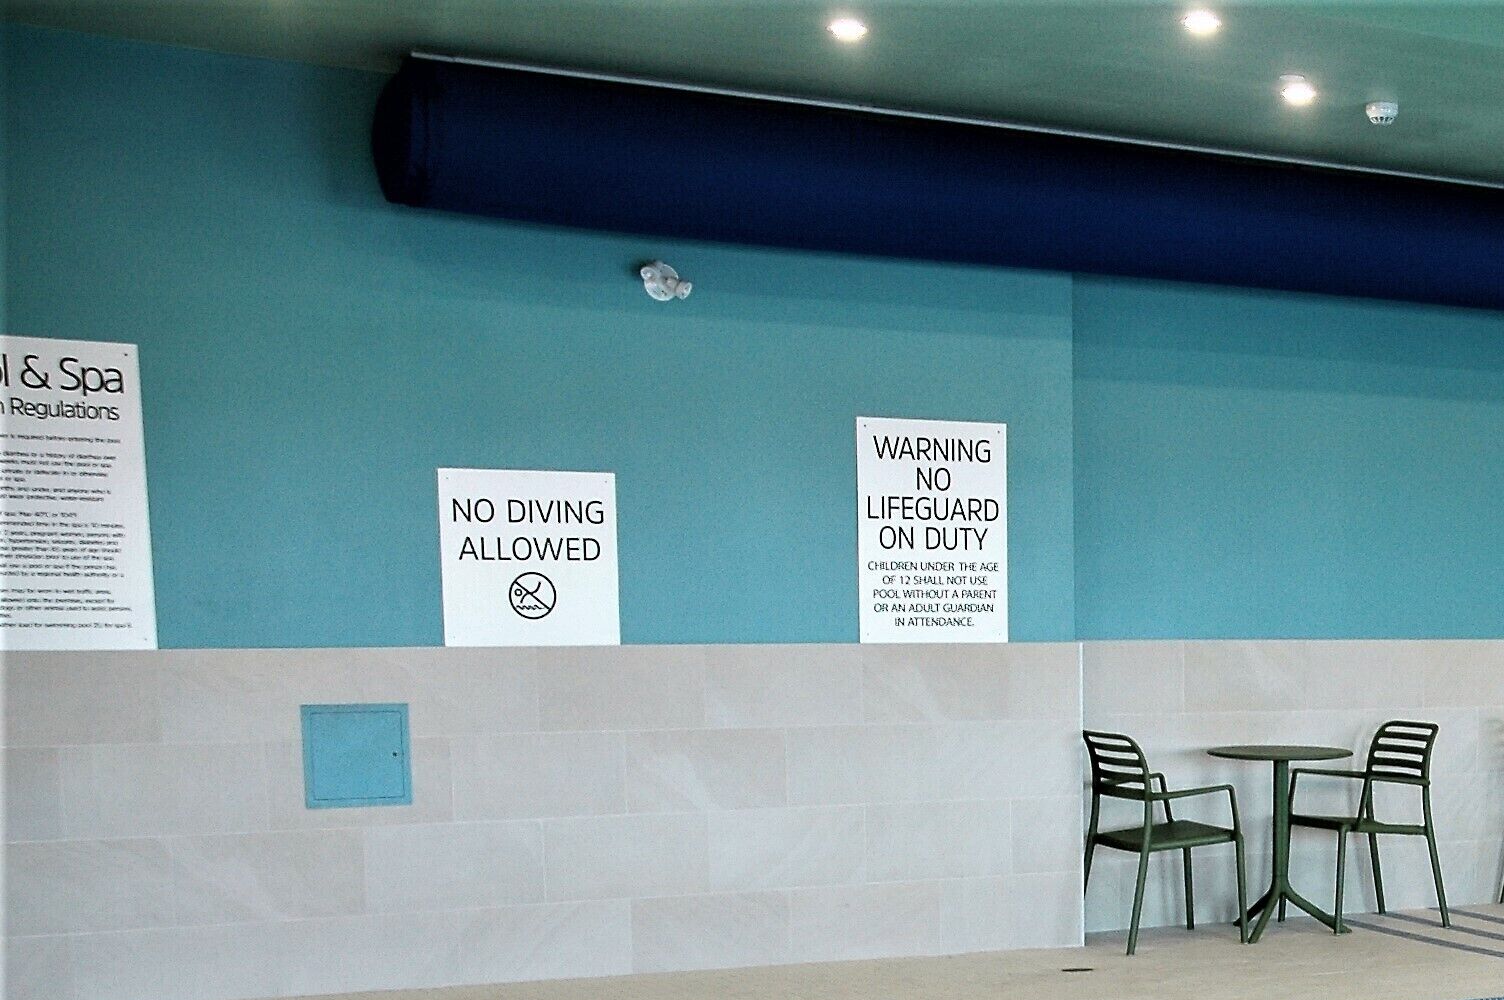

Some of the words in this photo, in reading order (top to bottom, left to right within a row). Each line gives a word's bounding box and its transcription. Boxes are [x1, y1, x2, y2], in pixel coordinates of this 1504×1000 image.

[20, 354, 52, 390] &
[60, 356, 124, 396] Spa
[10, 397, 120, 420] Regulations
[873, 435, 991, 463] WARNING
[916, 467, 951, 491] NO
[452, 498, 495, 523] NO
[507, 499, 604, 524] DIVING
[867, 496, 999, 521] LIFEGUARD
[459, 536, 601, 561] ALLOWED
[879, 526, 914, 549] ON
[926, 527, 988, 551] DUTY
[868, 561, 917, 571] CHILDREN
[920, 561, 955, 571] UNDER
[959, 561, 977, 571] THE
[980, 562, 998, 572] AGE
[882, 575, 896, 585] OF
[900, 575, 911, 585] 12
[914, 575, 944, 585] SHALL
[947, 576, 967, 585] NOT
[970, 576, 988, 585] USE
[873, 589, 901, 599] POOL
[903, 589, 948, 599] WITHOUT
[952, 590, 959, 599] A
[961, 590, 997, 599] PARENT
[874, 603, 889, 613] OR
[891, 603, 906, 613] AN
[909, 603, 940, 613] ADULT
[943, 603, 994, 613] GUARDIAN
[895, 617, 905, 627] IN
[908, 617, 975, 627] ATTENDANCE.
